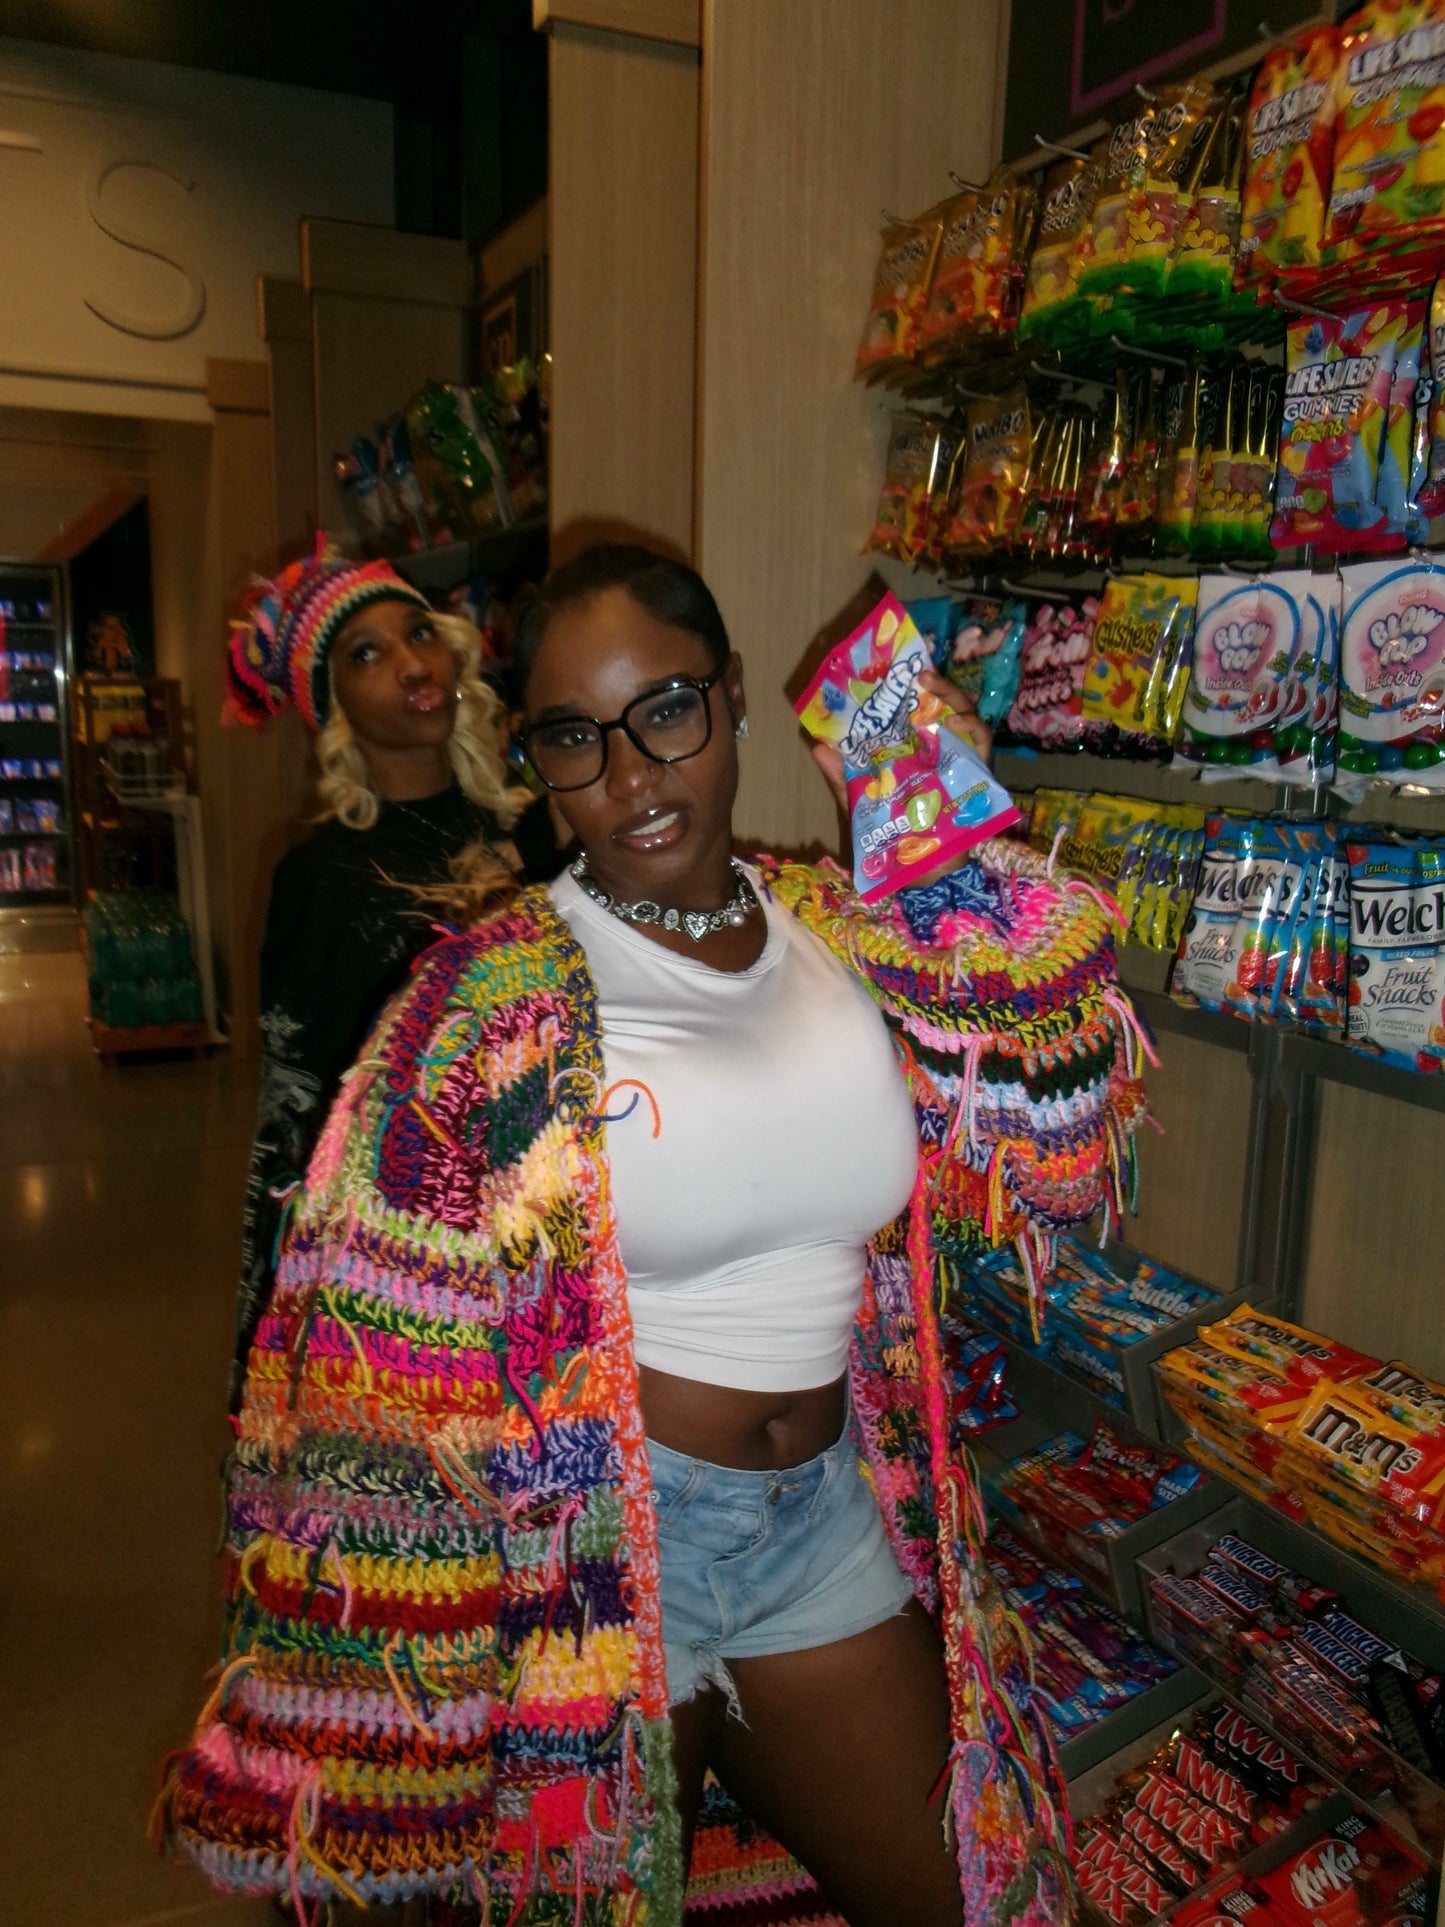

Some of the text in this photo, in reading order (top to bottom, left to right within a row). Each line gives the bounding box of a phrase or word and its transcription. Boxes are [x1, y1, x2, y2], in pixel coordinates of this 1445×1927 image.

[1284, 362, 1323, 396] LIFE
[1094, 617, 1162, 656] Gushers
[1212, 621, 1272, 653] BLOW
[1369, 605, 1445, 651] BLOW
[1363, 984, 1438, 1008] Snacks
[1380, 965, 1434, 989] Fruit
[1217, 1536, 1286, 1581] SNICKERS
[1202, 1566, 1266, 1612] SNICKERS
[1214, 1702, 1304, 1783] TWIX
[1175, 1734, 1257, 1824] TWIX
[1134, 1769, 1222, 1862] TWIX
[1334, 1815, 1359, 1836] KING
[1082, 1826, 1174, 1917] TWIX
